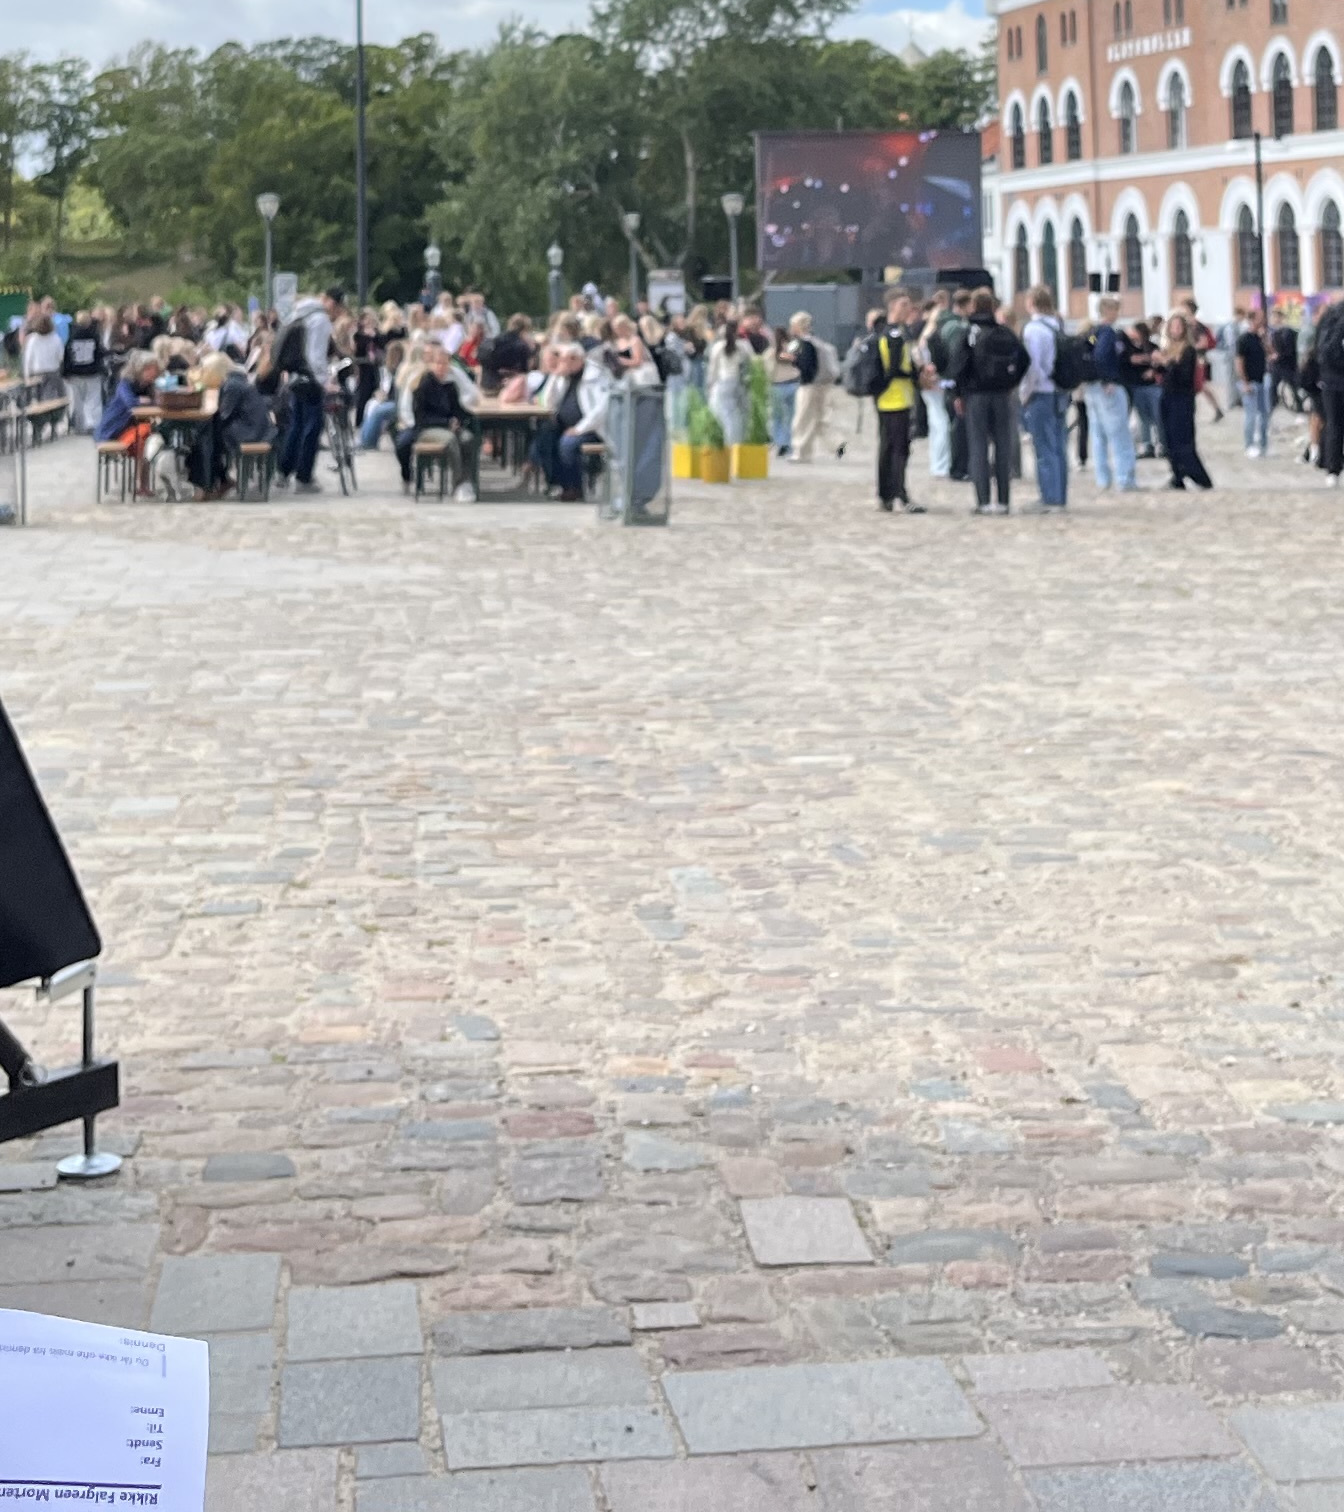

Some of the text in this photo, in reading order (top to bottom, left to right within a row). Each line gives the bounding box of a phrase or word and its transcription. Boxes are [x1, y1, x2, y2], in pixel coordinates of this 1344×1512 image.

[130, 1406, 164, 1417] Emne:
[146, 1424, 163, 1433] Til:
[126, 1439, 163, 1450] Sendt:
[140, 1456, 161, 1467] Fra:
[54, 1486, 115, 1503] Falgreen
[120, 1492, 158, 1504] Rikke
